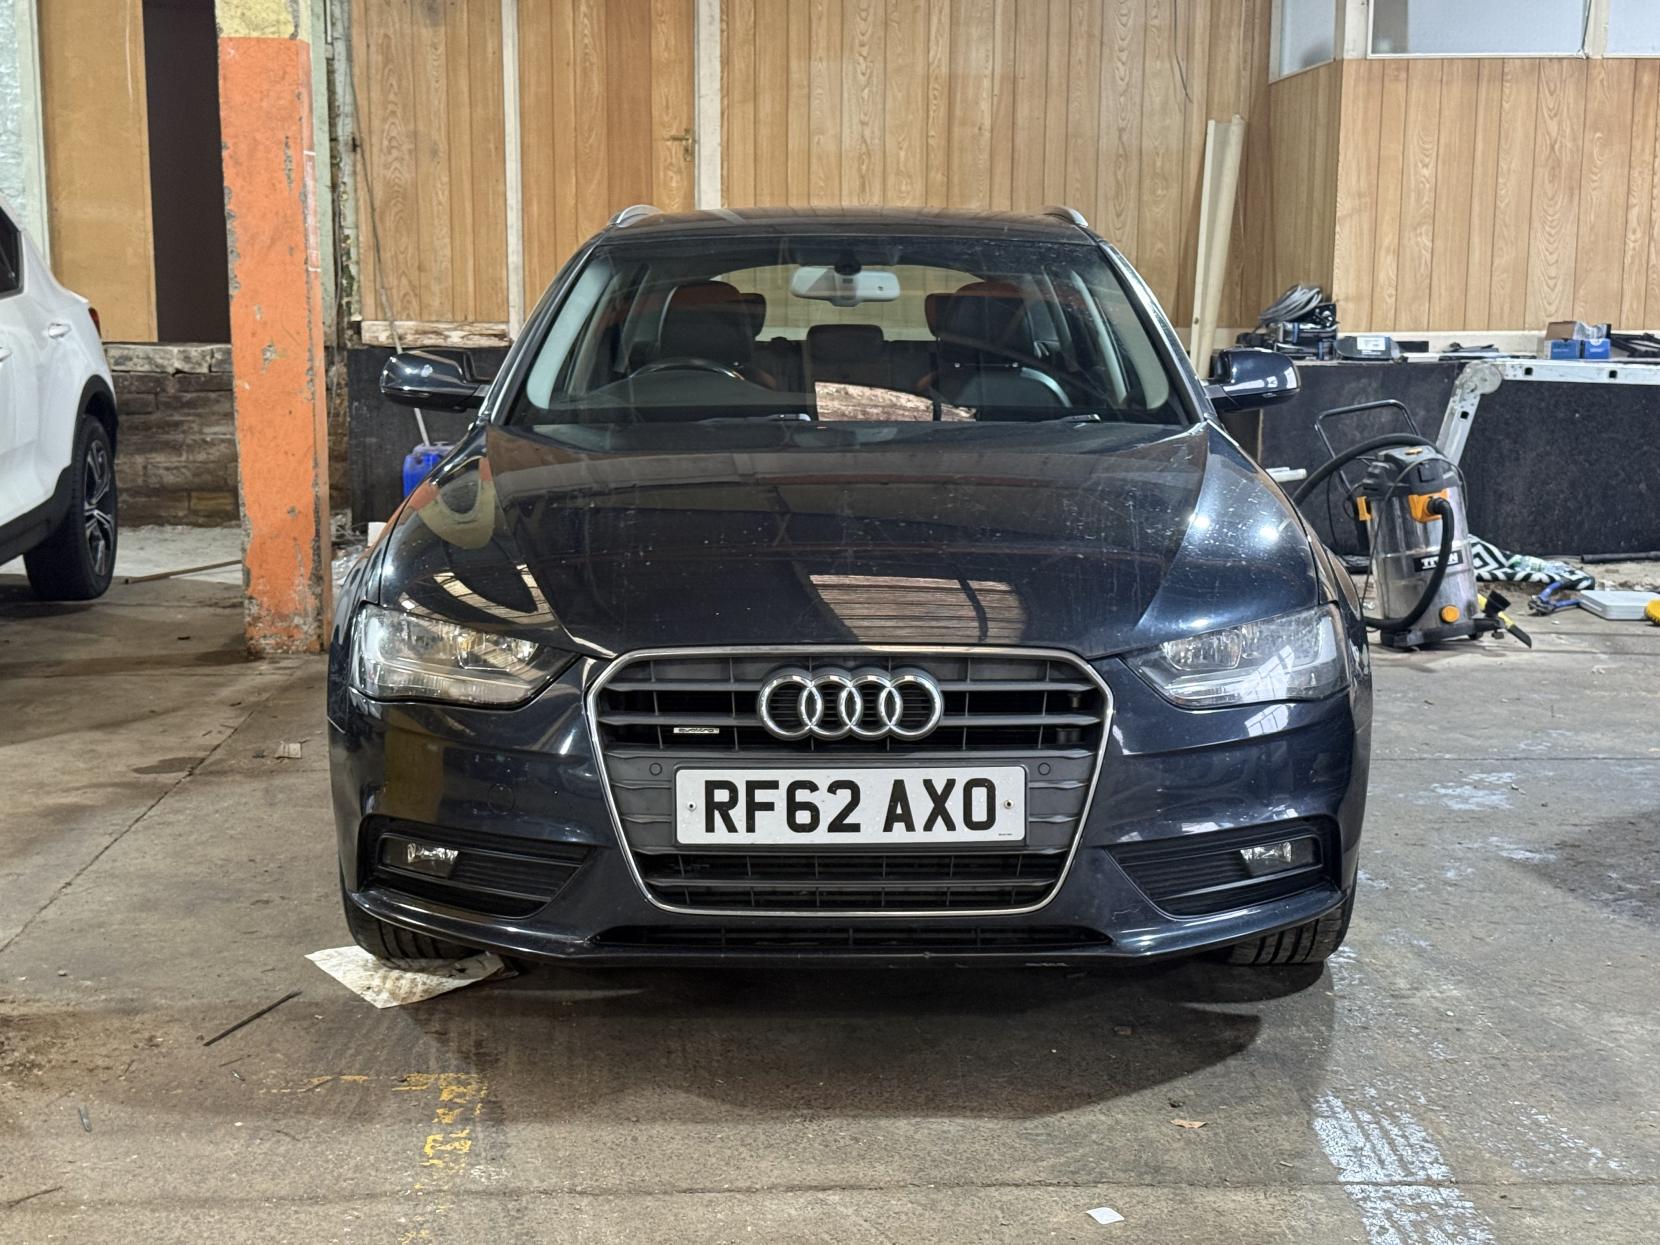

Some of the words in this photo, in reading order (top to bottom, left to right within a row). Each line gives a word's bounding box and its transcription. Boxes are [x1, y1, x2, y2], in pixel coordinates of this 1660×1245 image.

[1421, 552, 1459, 569] TIN
[704, 779, 861, 833] RF62
[882, 777, 997, 833] AXO
